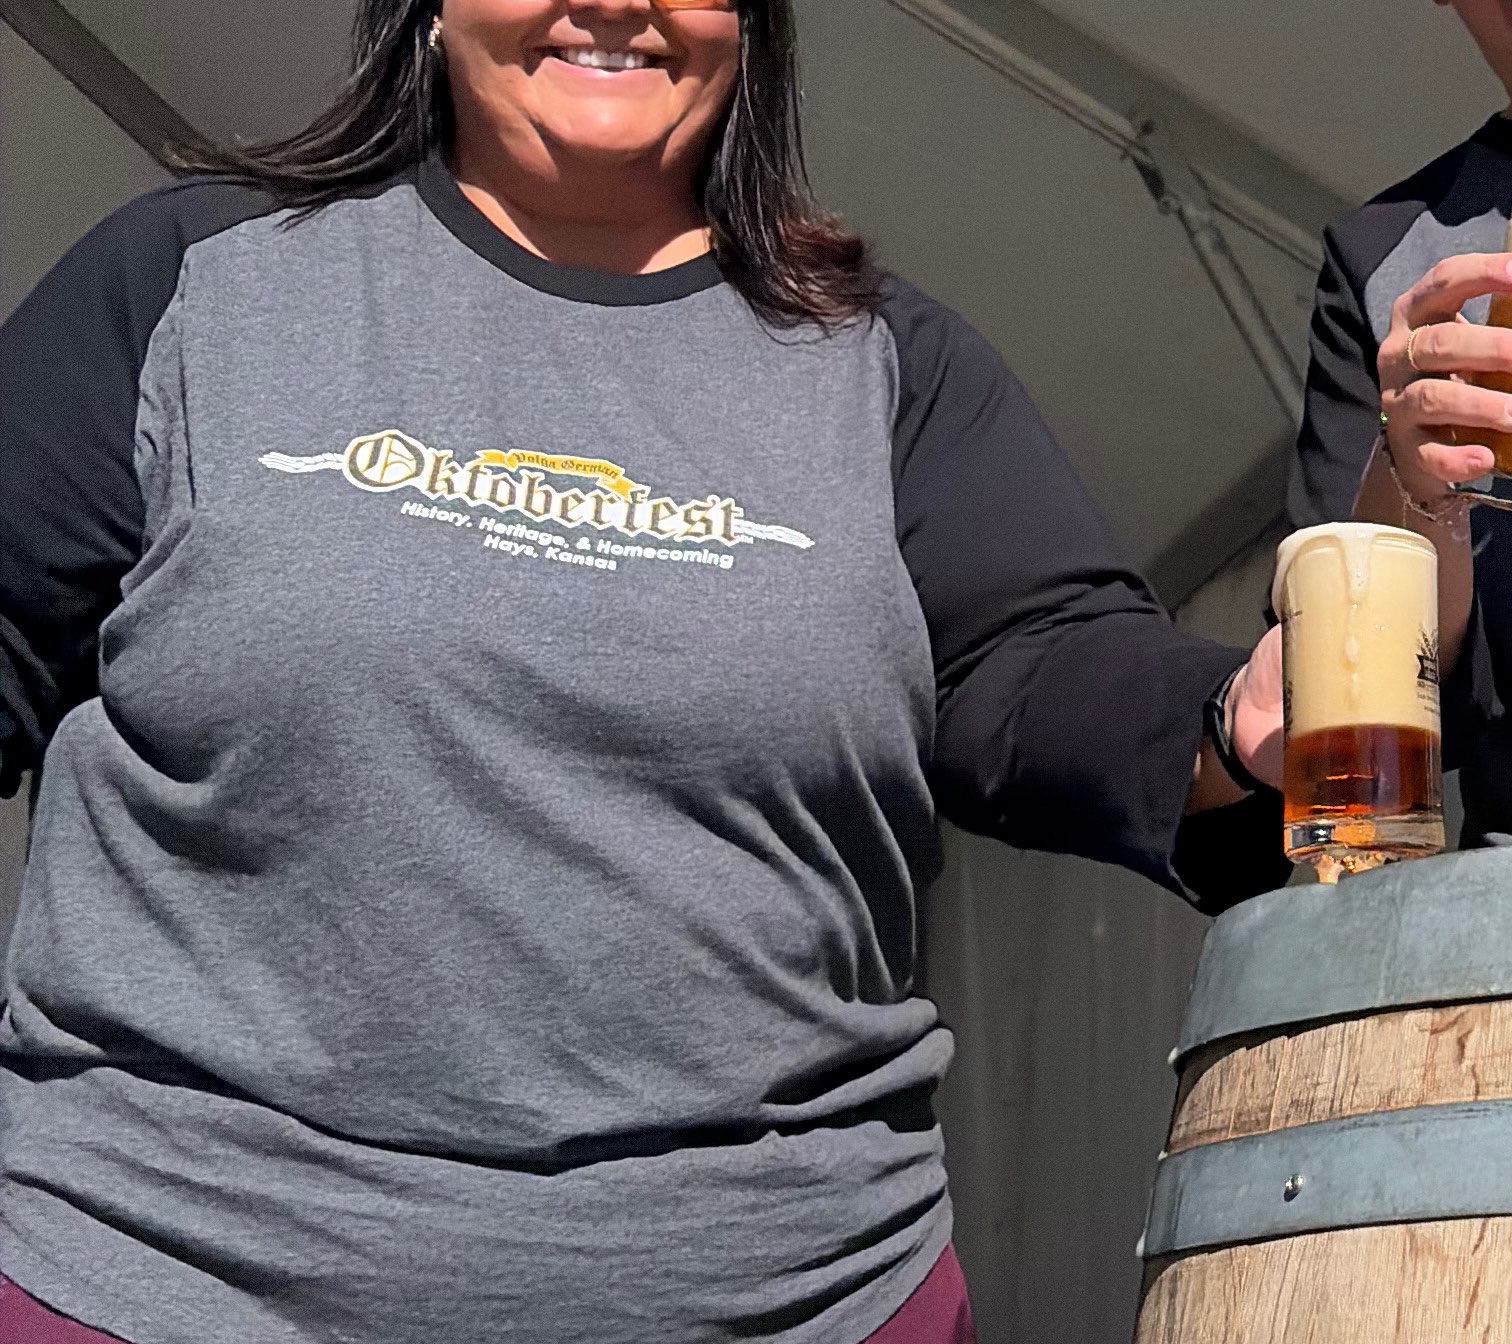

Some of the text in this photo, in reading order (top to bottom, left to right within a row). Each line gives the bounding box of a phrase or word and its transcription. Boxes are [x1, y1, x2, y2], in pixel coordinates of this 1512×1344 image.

[513, 451, 619, 479] Volga German
[344, 430, 744, 545] Oktoberfest
[545, 545, 617, 571] Kansas
[576, 536, 591, 551] &
[597, 538, 734, 570] Homecoming
